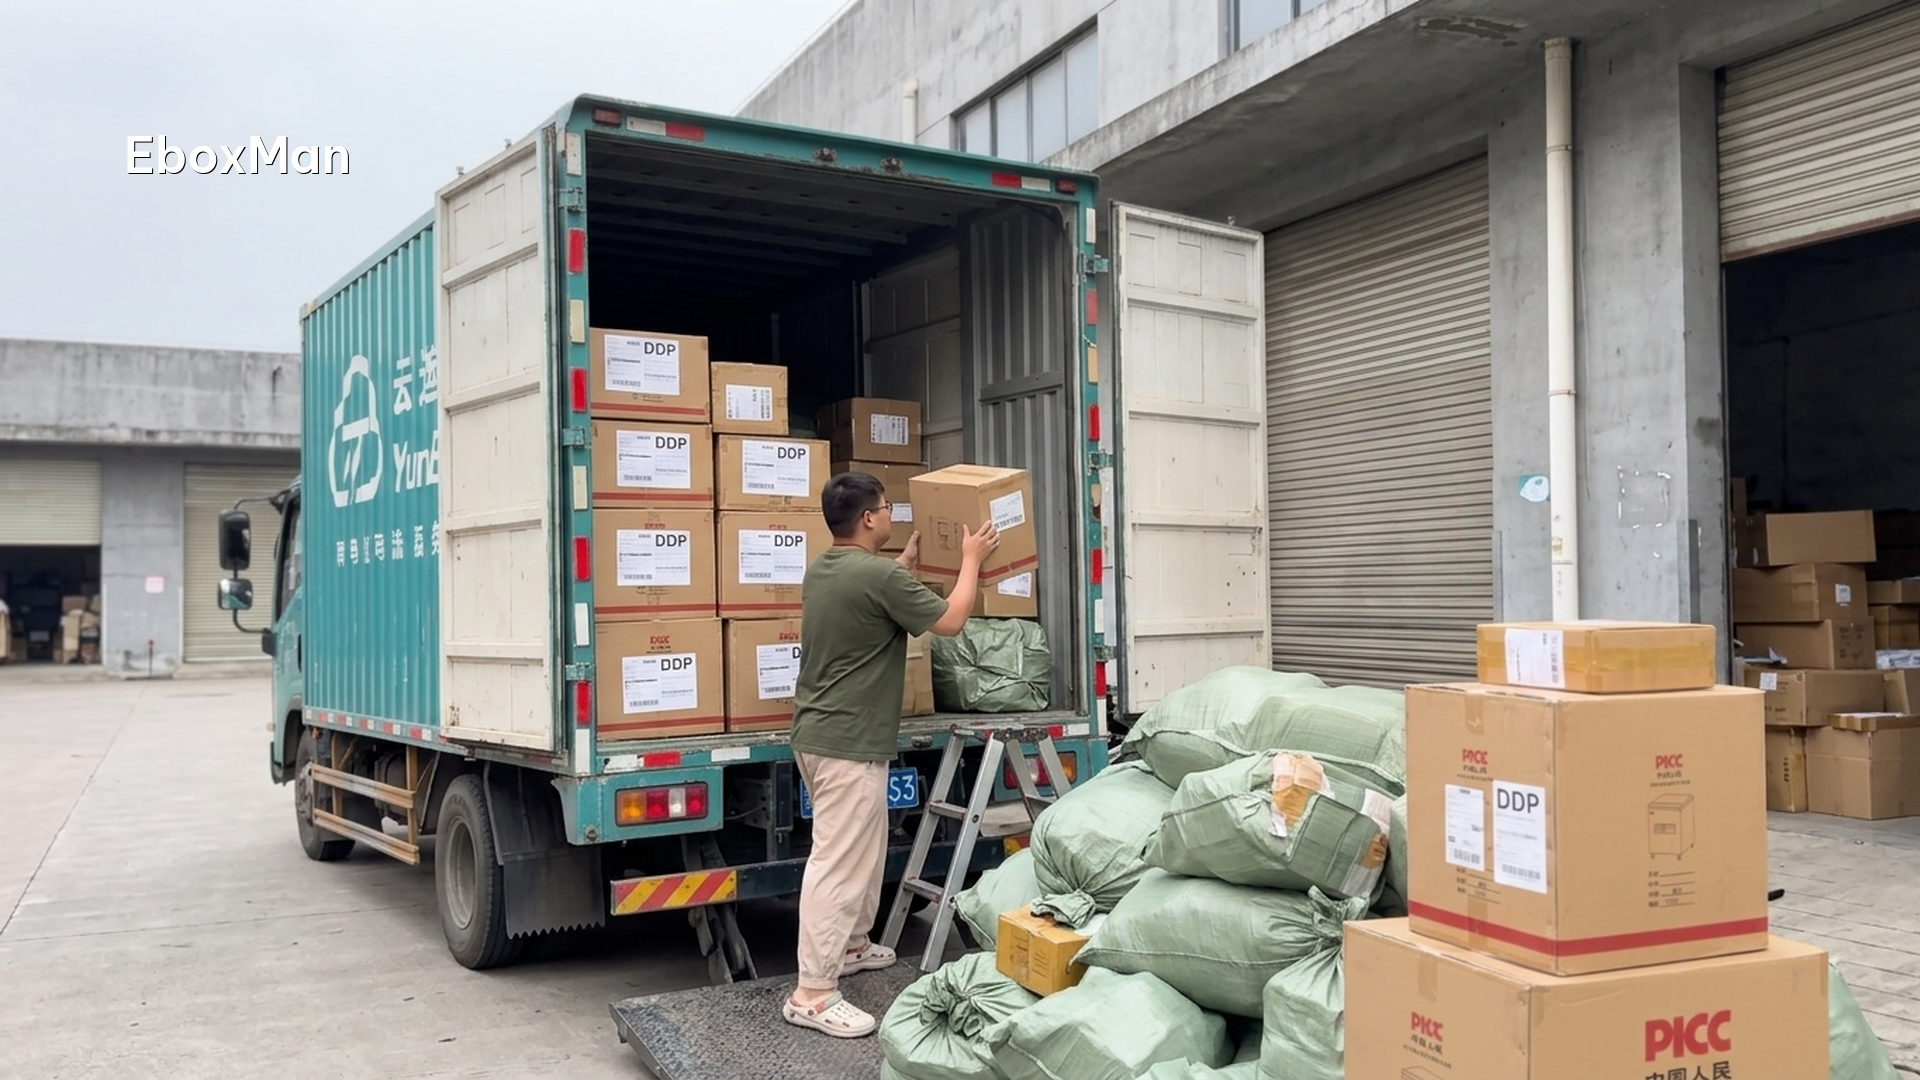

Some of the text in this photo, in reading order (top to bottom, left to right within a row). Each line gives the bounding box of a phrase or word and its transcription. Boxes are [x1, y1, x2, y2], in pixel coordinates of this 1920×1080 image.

[644, 341, 676, 356] DDP
[655, 436, 687, 450] DDP
[777, 447, 806, 460] DDP
[655, 534, 687, 547] DDP
[774, 534, 803, 547] DDP
[661, 657, 693, 671] DDP
[1655, 754, 1683, 769] PICC
[1497, 788, 1539, 813] DDP
[1645, 1009, 1732, 1062] PICC
